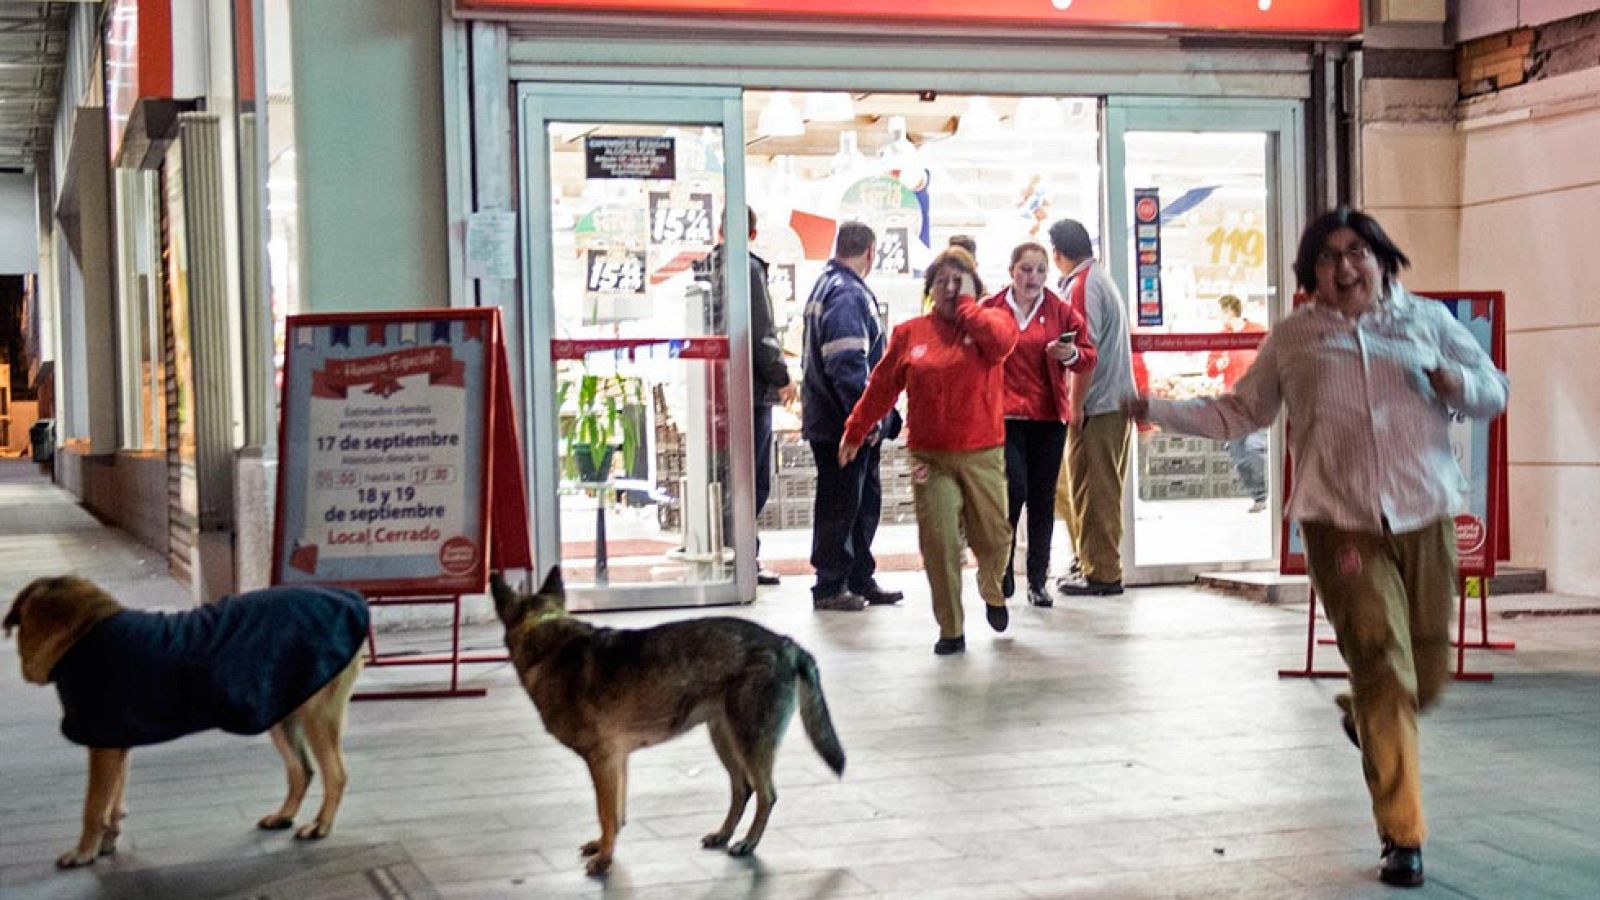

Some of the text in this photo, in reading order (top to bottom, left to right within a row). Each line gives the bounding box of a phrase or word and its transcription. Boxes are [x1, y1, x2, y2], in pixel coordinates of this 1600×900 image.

[652, 207, 712, 242] 15%
[316, 430, 459, 452] 17 de septiembre
[358, 486, 416, 505] 18 y 19
[324, 503, 445, 523] de septiembre
[327, 525, 441, 545] Local Cerrado
